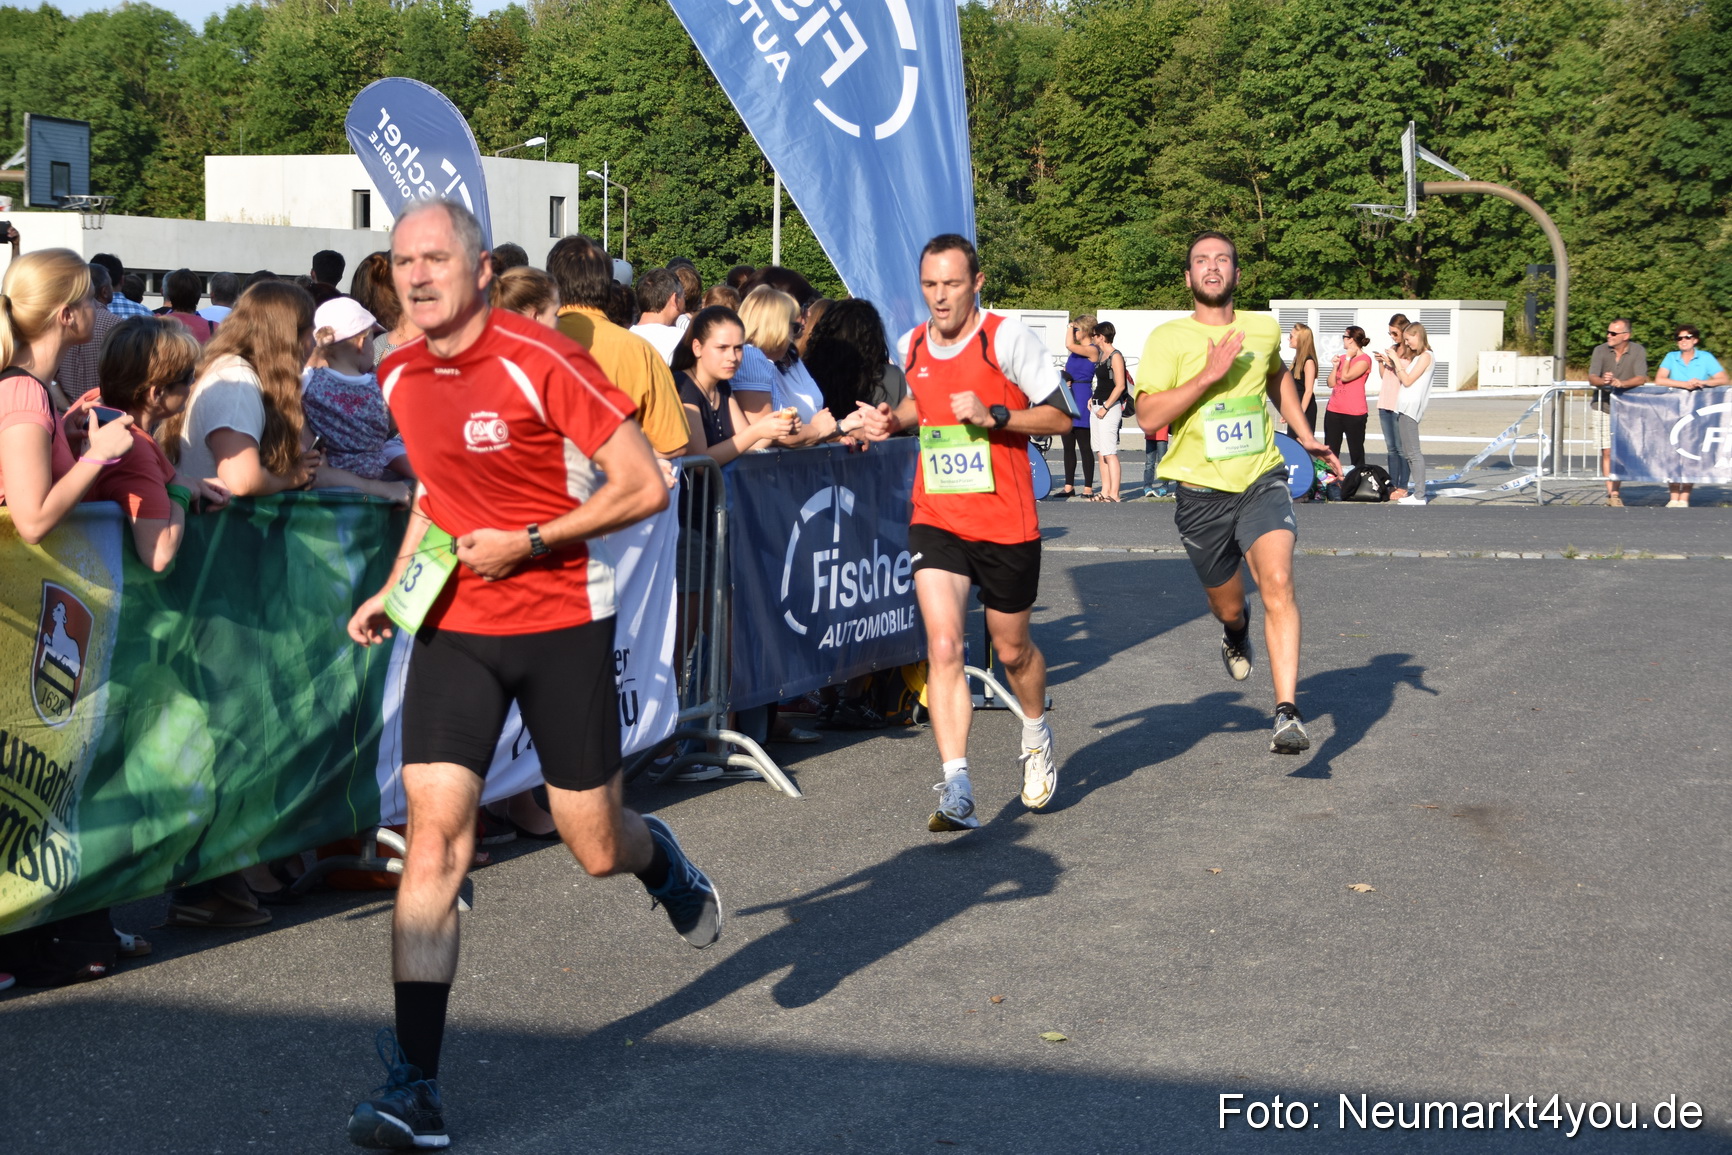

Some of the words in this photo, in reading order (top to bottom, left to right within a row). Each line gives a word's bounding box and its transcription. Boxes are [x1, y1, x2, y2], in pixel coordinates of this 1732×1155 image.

[1216, 420, 1253, 442] 641
[929, 451, 984, 475] 1394
[811, 539, 916, 614] Fische
[818, 604, 915, 650] AUTOMOBILE
[40, 686, 65, 717] 1628
